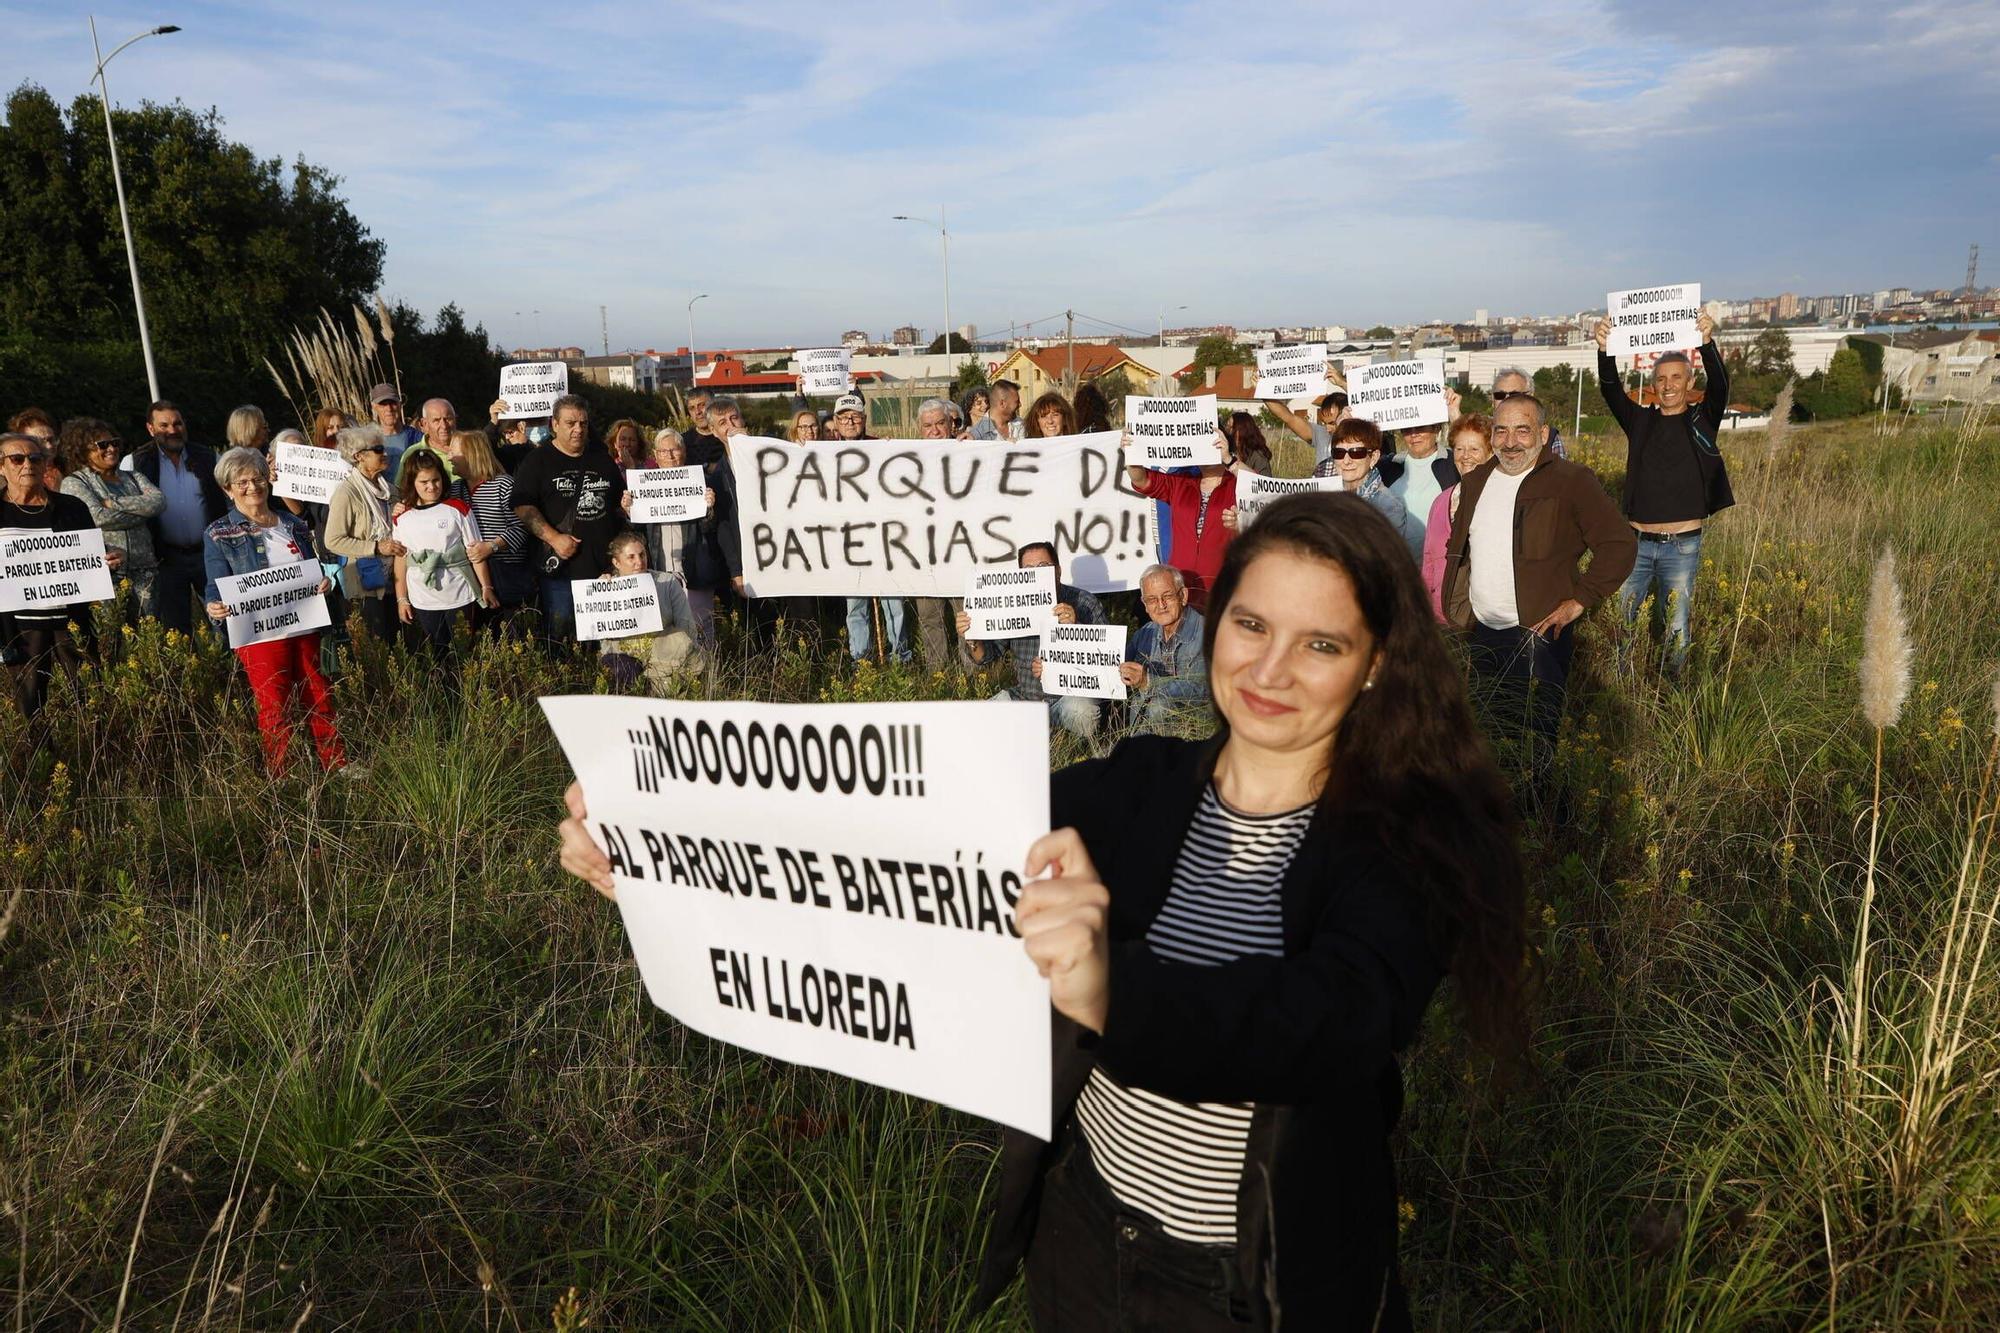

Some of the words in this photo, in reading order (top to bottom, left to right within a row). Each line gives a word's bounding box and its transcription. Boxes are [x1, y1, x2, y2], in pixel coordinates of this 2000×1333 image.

[1619, 313, 1648, 327] PARQUE
[1650, 312, 1659, 324] DE
[1630, 335, 1639, 347] EN
[1641, 332, 1675, 346] LLOREDA
[1266, 367, 1288, 379] PARQUE
[1289, 366, 1296, 376] DE
[505, 384, 527, 395] PARQUE
[528, 384, 536, 394] DE
[1274, 385, 1281, 394] EN
[1282, 383, 1307, 394] LLOREDA
[1351, 393, 1360, 405] AL
[1360, 388, 1390, 403] PARQUE
[1392, 386, 1402, 399] DE
[514, 402, 522, 412] EN
[523, 401, 551, 412] LLOREDA
[1373, 411, 1384, 424] EN
[1385, 406, 1420, 422] LLOREDA
[1135, 423, 1164, 437] PARQUE
[1165, 424, 1175, 436] DE
[1147, 446, 1157, 458] EN
[1158, 446, 1193, 459] LLOREDA
[284, 463, 307, 477] PARQUE
[308, 467, 317, 478] DE
[754, 446, 1041, 512] PARQUE
[291, 482, 299, 493] EN
[640, 488, 663, 499] PARQUE
[665, 488, 673, 498] DE
[650, 506, 659, 517] EN
[660, 505, 687, 516] LLOREDA
[1239, 498, 1248, 513] AL
[1054, 509, 1148, 562] NO!!
[5, 562, 43, 579] PARQUE
[44, 561, 57, 575] DE
[24, 586, 37, 601] EN
[38, 582, 80, 599] LLOREDA
[228, 604, 240, 617] AL
[240, 596, 271, 615] PARQUE
[273, 594, 283, 606] DE
[576, 603, 584, 614] AL
[585, 601, 612, 613] PARQUE
[613, 600, 623, 612] DE
[965, 597, 973, 609] AL
[974, 596, 1003, 609] PARQUE
[1004, 595, 1014, 608] DE
[254, 621, 264, 634] EN
[266, 611, 300, 631] LLOREDA
[597, 621, 607, 632] EN
[607, 617, 638, 632] LLOREDA
[985, 619, 996, 631] EN
[997, 617, 1031, 631] LLOREDA
[1049, 649, 1075, 665] PARQUE
[1076, 651, 1085, 665] DE
[1059, 674, 1068, 688] EN
[1070, 674, 1100, 690] LLOREDA
[628, 715, 925, 797] ¡¡¡NOOOOOOOO!!!
[599, 822, 645, 880] AL
[639, 828, 777, 900] PARQUE
[776, 845, 832, 910] DE
[708, 946, 756, 1013] EN
[761, 955, 916, 1051] LLOREDA
